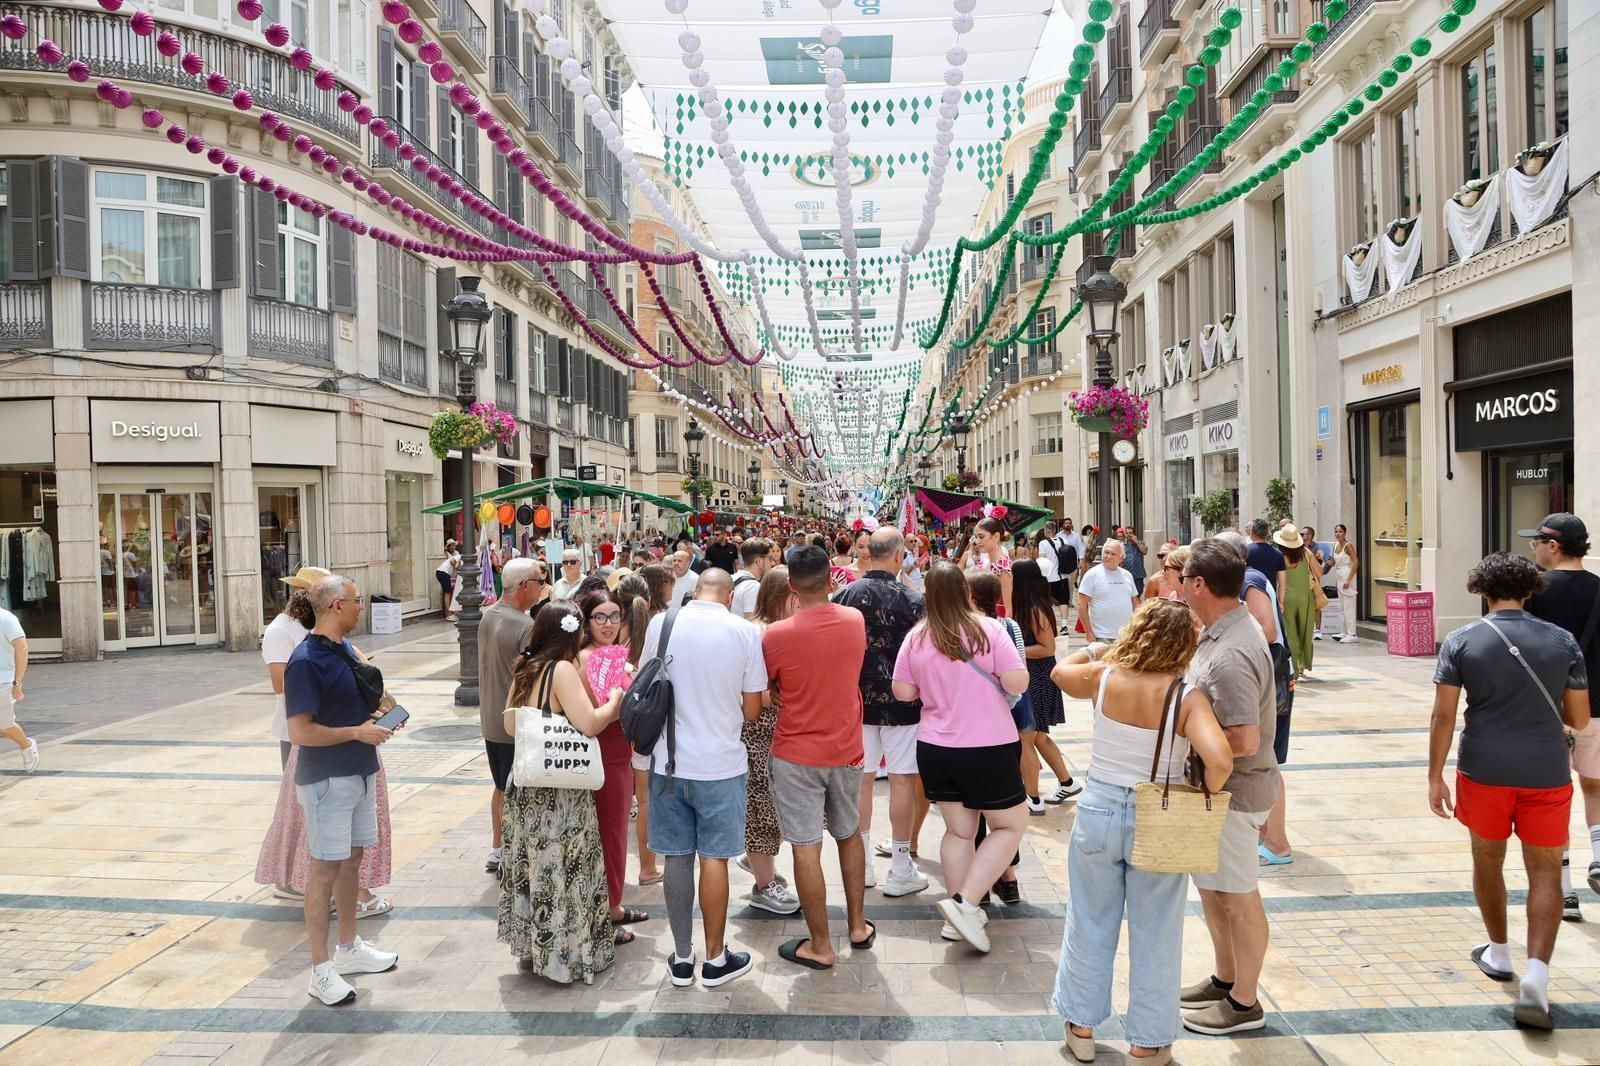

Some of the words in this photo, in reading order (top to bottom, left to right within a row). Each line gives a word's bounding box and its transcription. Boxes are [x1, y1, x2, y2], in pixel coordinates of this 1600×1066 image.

[1475, 388, 1558, 423] MARCOS
[111, 420, 203, 442] Desigual.
[1208, 422, 1233, 444] KIKO
[1169, 433, 1189, 453] KIKO
[1516, 468, 1549, 480] HUBLOT
[544, 741, 589, 753] PUPPY
[544, 758, 591, 770] PUPPY
